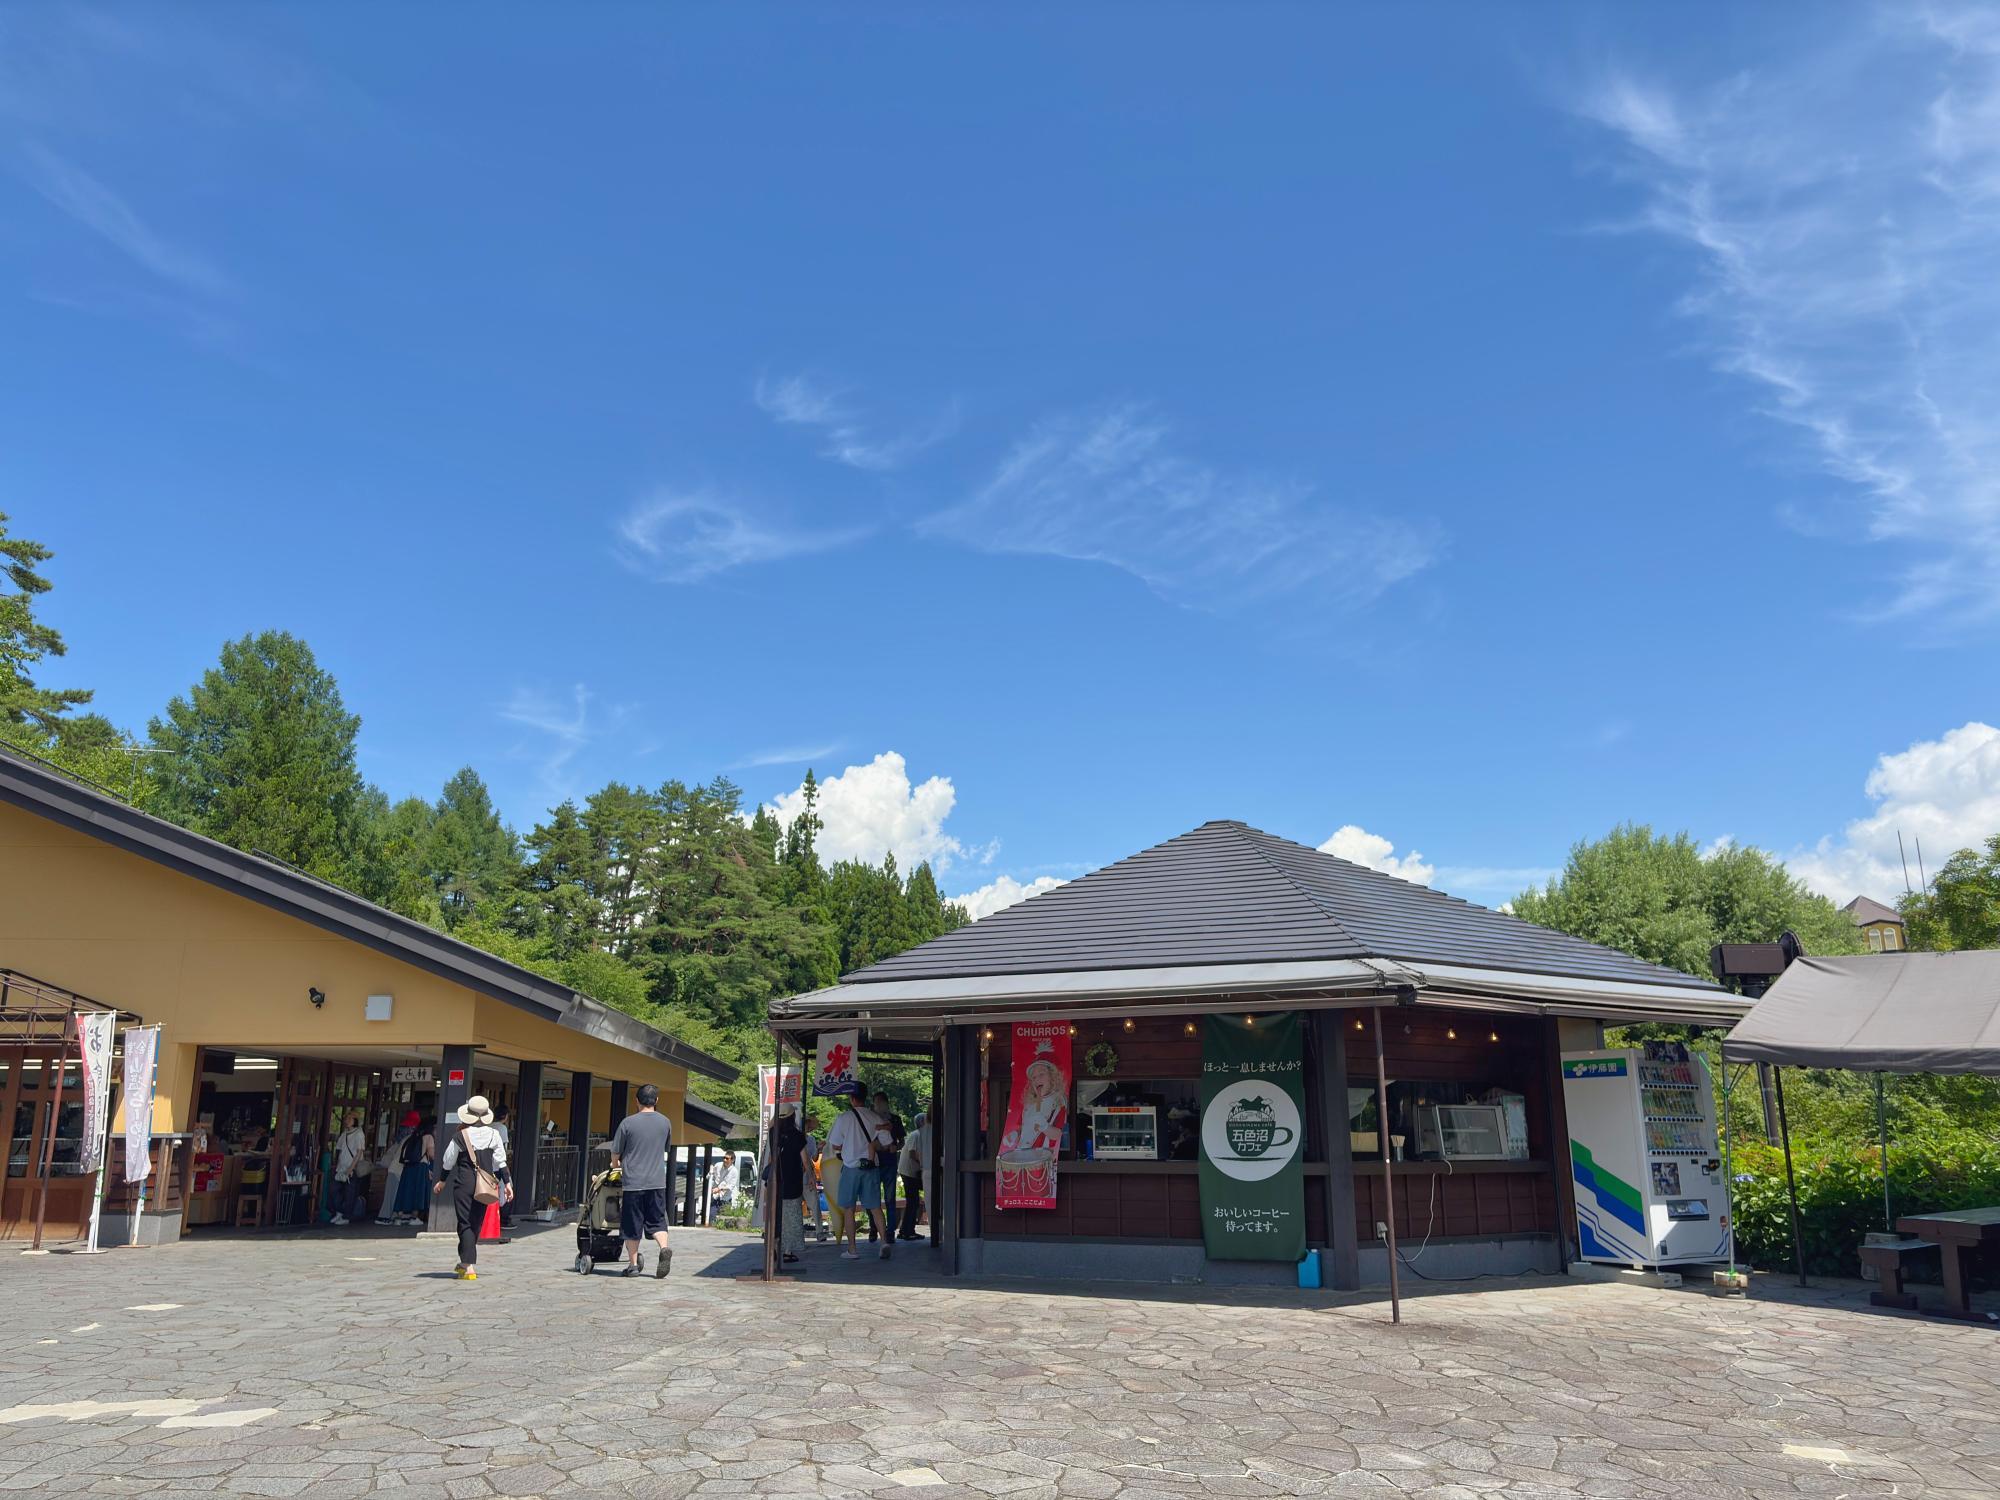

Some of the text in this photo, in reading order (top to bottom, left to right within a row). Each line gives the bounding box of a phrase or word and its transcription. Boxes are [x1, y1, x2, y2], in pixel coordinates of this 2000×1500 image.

[1017, 1026, 1066, 1037] CHURROS
[823, 1043, 853, 1077] 氷
[1232, 1129, 1269, 1142] 五色沼
[1237, 1142, 1262, 1152] カフェ
[1214, 1206, 1290, 1219] おいしいコーヒー
[1226, 1220, 1278, 1233] 待ってます。
